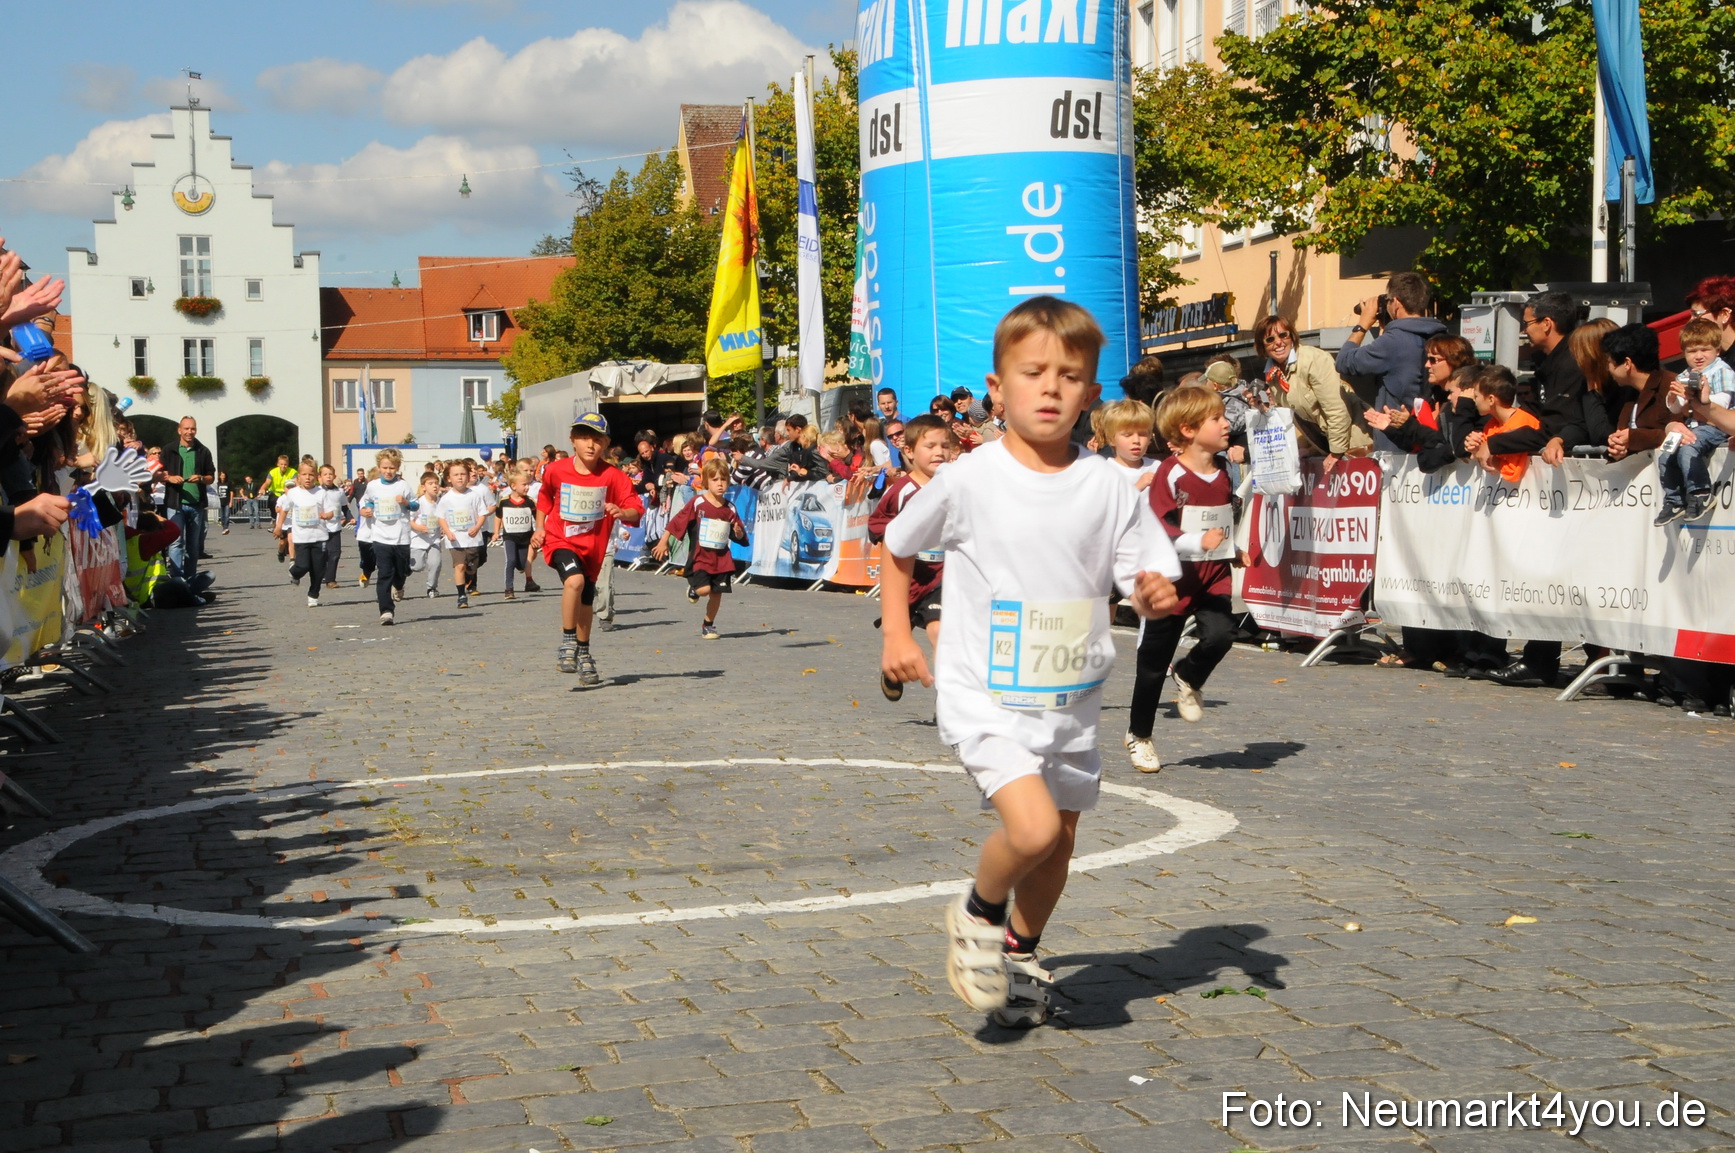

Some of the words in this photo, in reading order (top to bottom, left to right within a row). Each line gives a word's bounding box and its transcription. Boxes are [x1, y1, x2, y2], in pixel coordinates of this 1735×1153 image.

[945, 0, 1101, 48] maxi
[1050, 90, 1102, 140] dsl
[869, 102, 903, 158] dsl
[572, 487, 594, 497] Lorenz
[1327, 470, 1377, 498] 50390
[1388, 475, 1420, 504] Gute
[1427, 476, 1472, 505] Ideen
[1477, 476, 1531, 509] haben
[1539, 481, 1565, 511] ein
[1569, 479, 1657, 511] Zuhause.
[573, 499, 602, 510] 7039
[771, 492, 781, 505] SO
[456, 515, 472, 523] 7034
[505, 516, 530, 525] 10220
[1201, 511, 1218, 521] Elias
[1293, 516, 1306, 540] ZU
[1500, 580, 1544, 604] Telefon:
[1548, 584, 1588, 607] 09181
[1029, 610, 1064, 631] Finn
[995, 640, 1012, 656] K2
[1030, 641, 1106, 674] 7088
